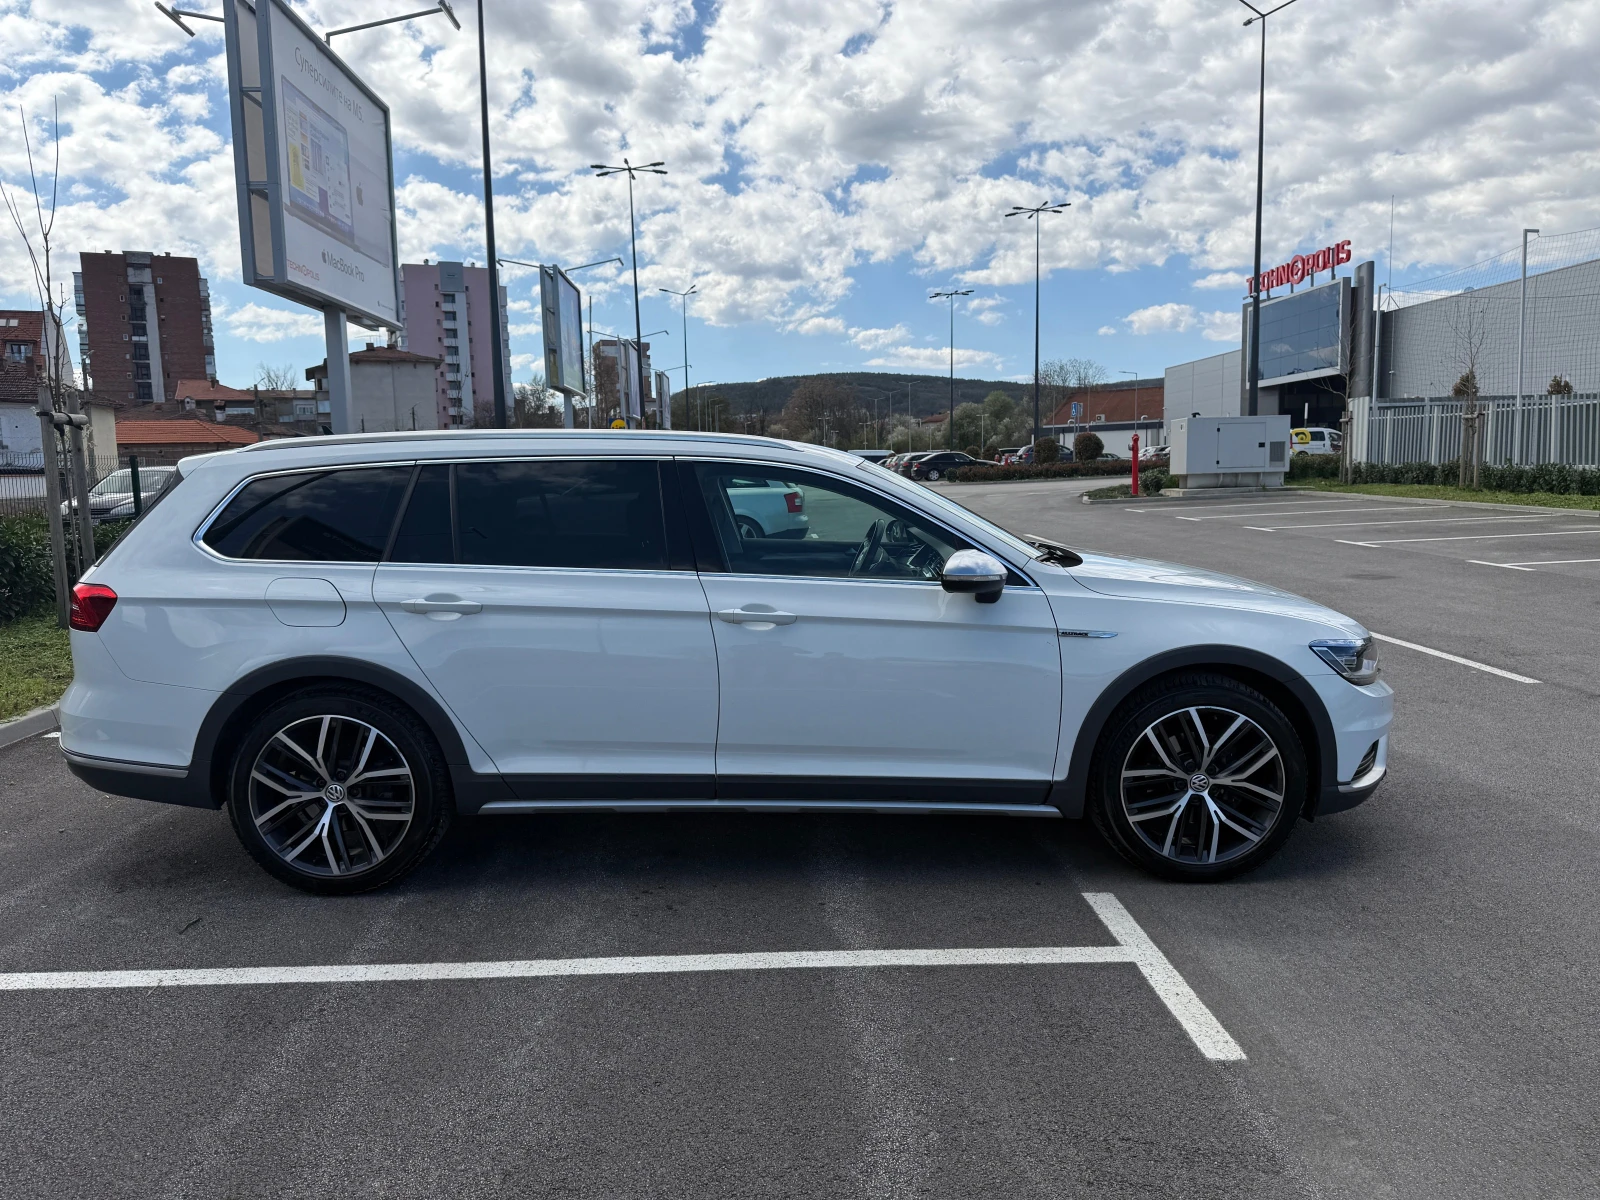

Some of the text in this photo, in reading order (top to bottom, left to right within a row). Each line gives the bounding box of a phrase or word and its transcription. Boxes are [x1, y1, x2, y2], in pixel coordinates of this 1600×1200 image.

[286, 260, 320, 281] TECHNOPOLIS
[326, 251, 365, 282] MacBook Pro
[1246, 240, 1351, 295] TCHNOPOLIS
